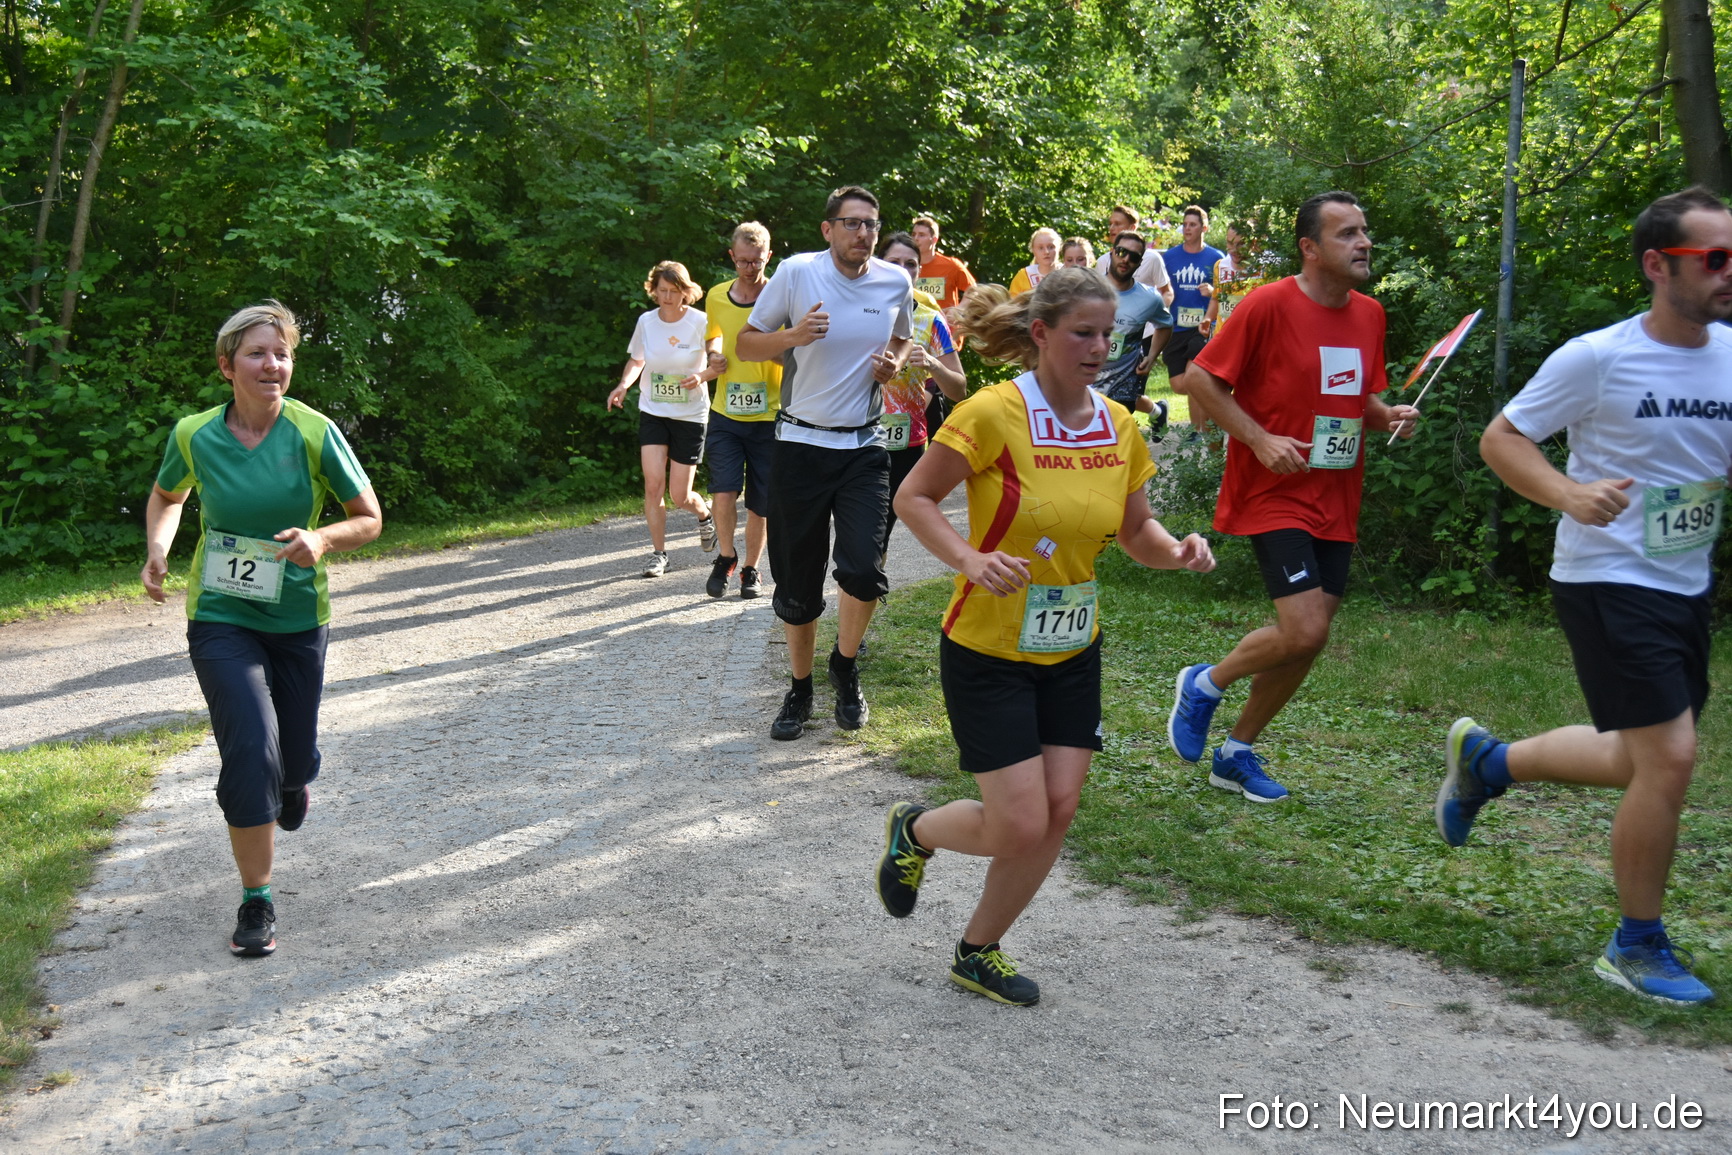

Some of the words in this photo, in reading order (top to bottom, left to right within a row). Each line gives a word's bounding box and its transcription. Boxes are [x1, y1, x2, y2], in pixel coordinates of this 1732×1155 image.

[1181, 314, 1200, 323] 1714
[655, 383, 681, 396] 1351
[730, 393, 762, 406] 2194
[1326, 436, 1356, 455] 540
[1033, 454, 1076, 470] MAX
[1079, 451, 1126, 470] BÖGL
[1656, 502, 1715, 536] 1498
[228, 557, 257, 582] 12
[216, 576, 241, 587] Schmidt
[241, 581, 264, 590] Marion
[1035, 607, 1088, 634] 1710
